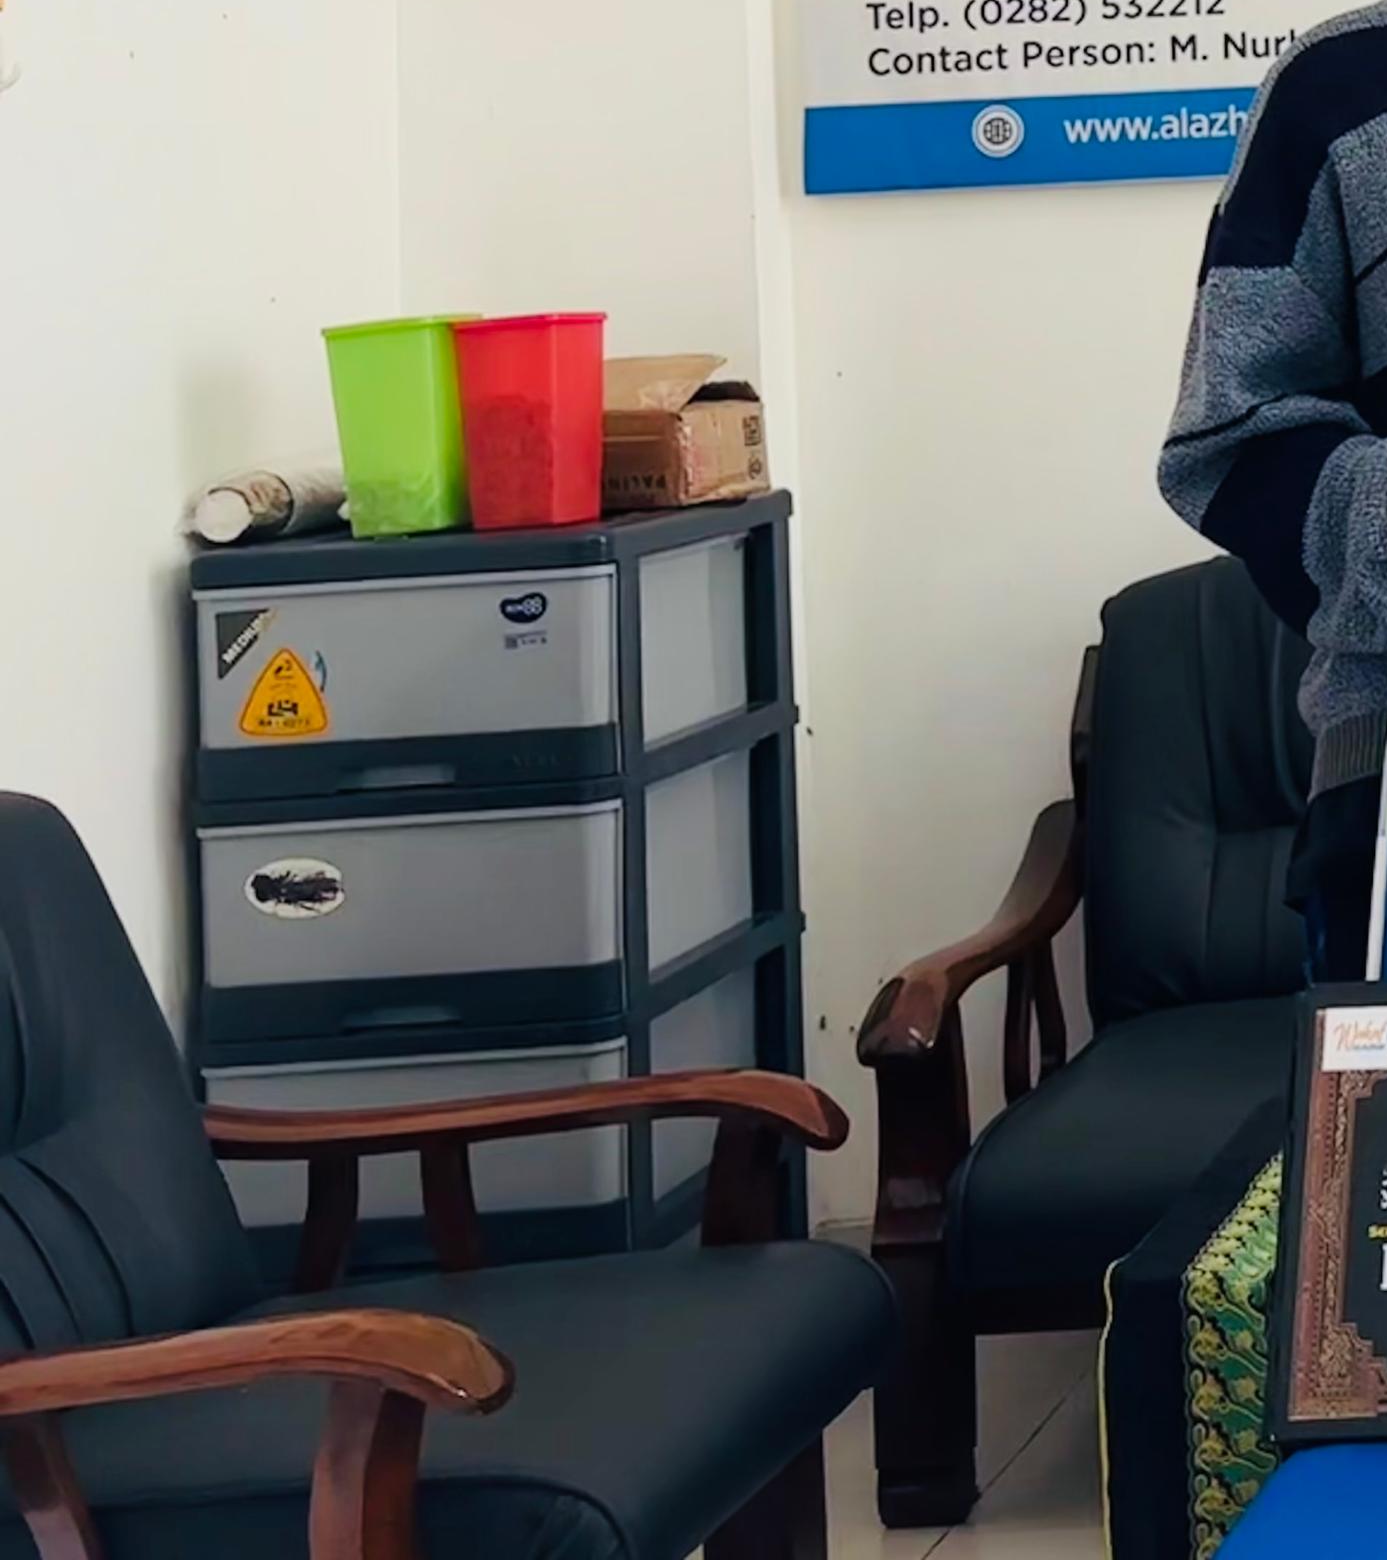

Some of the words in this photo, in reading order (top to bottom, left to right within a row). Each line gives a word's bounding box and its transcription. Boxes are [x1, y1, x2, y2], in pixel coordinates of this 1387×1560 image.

[866, 1, 949, 34] Telp.
[868, 43, 1009, 76] Contact
[1023, 38, 1156, 72] Person:
[1170, 35, 1208, 62] M.
[1224, 28, 1295, 59] Nur
